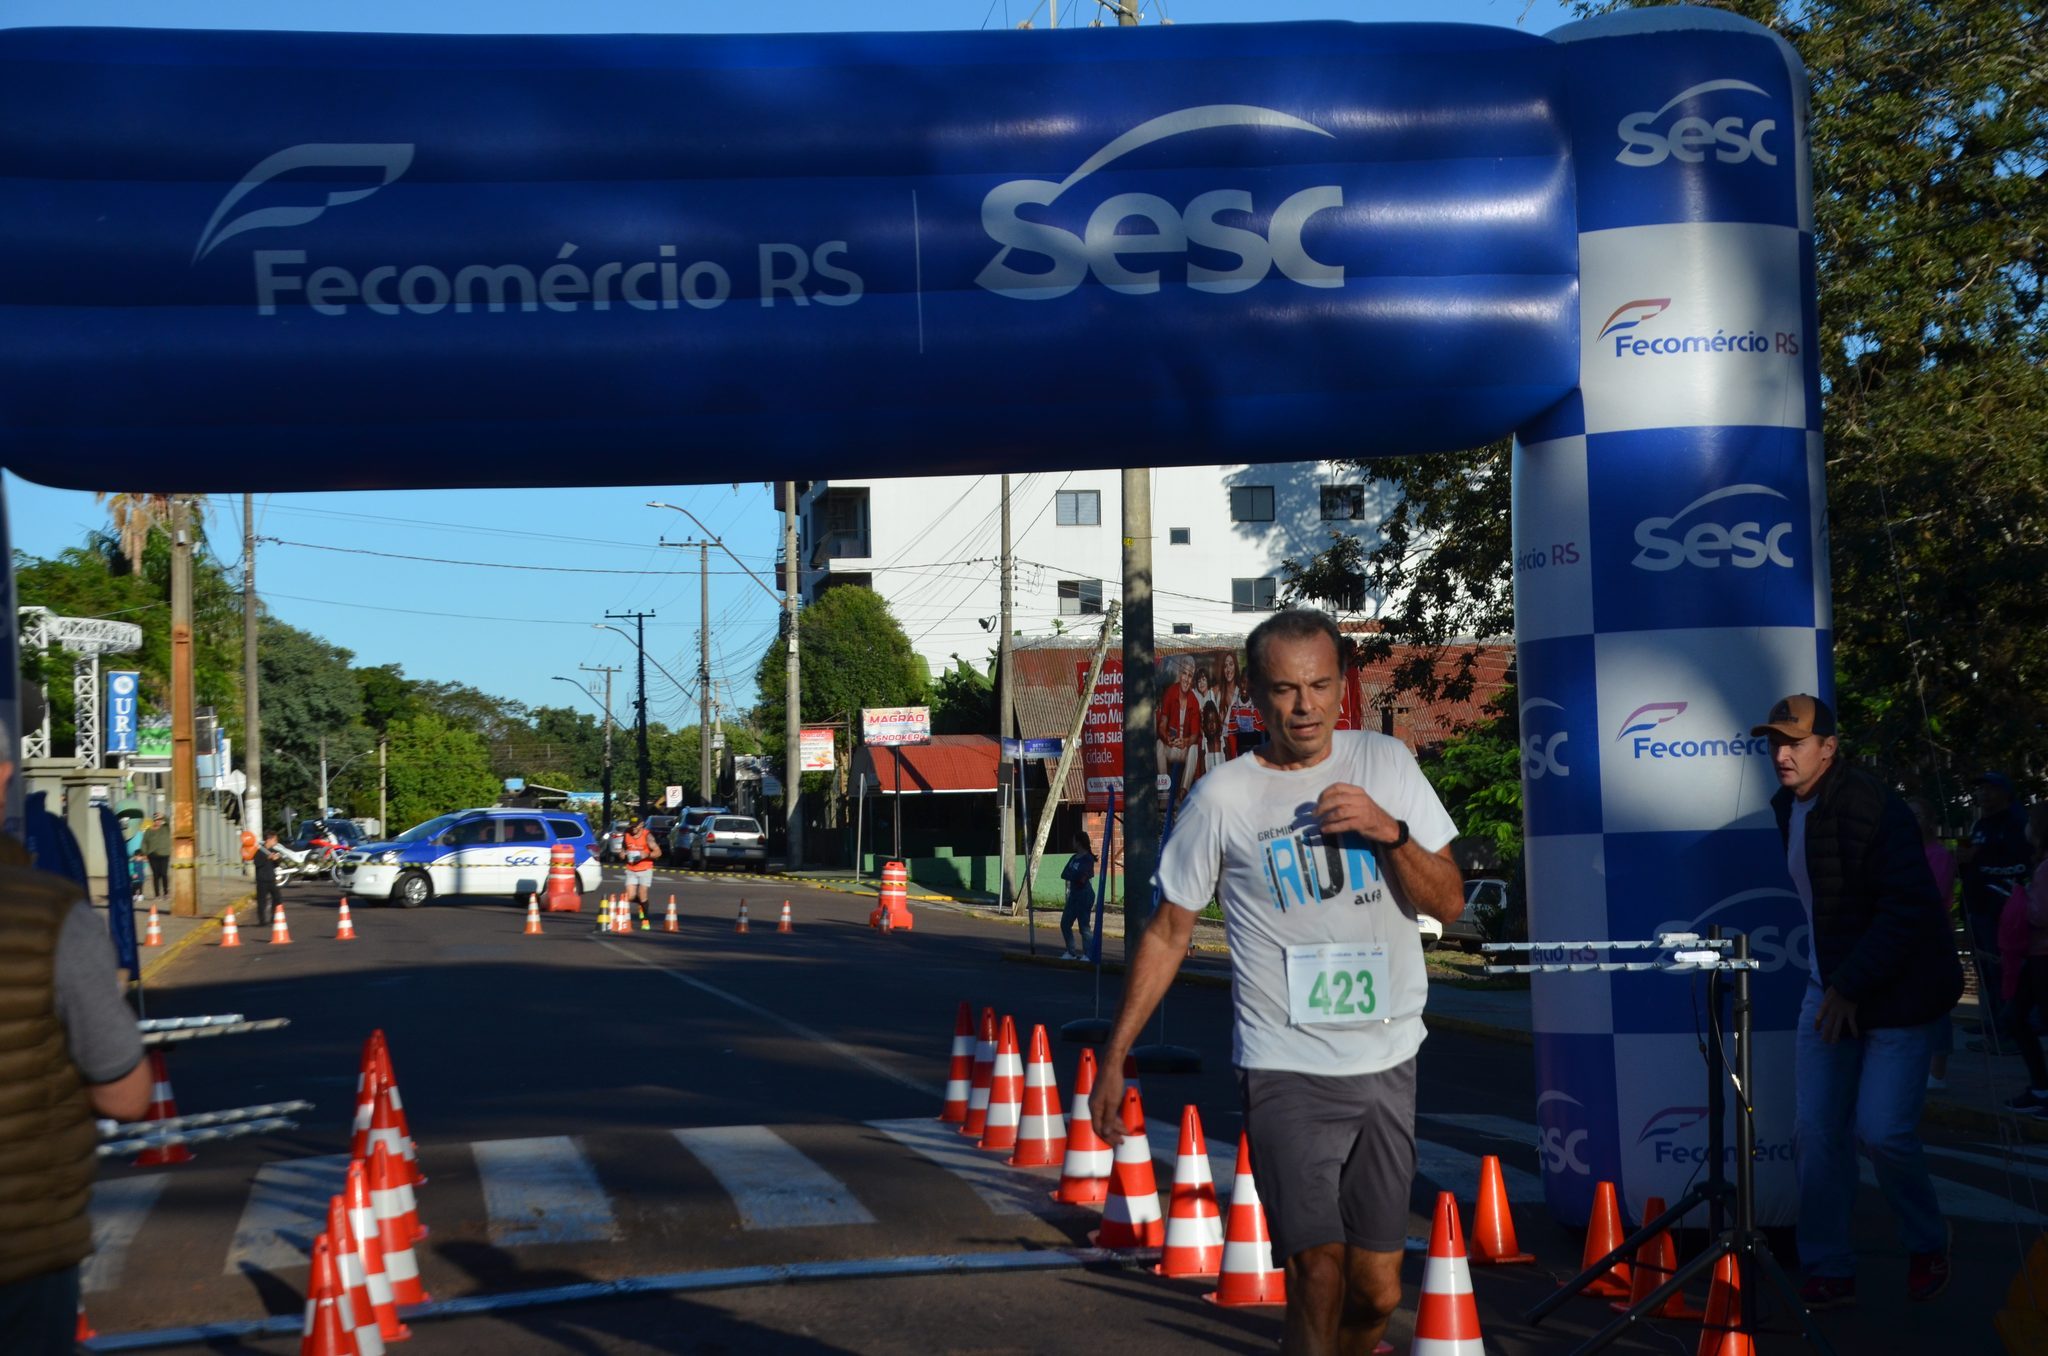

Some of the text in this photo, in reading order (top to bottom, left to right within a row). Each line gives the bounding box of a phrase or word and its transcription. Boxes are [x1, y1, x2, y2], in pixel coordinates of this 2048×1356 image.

[1615, 111, 1777, 167] Sesc
[974, 179, 1345, 300] Sesc
[253, 240, 864, 316] Fecomércio RS
[1616, 329, 1799, 357] Fecomércio RS
[1552, 542, 1580, 566] RS
[1631, 517, 1794, 571] Sesc
[114, 698, 132, 750] URI
[1094, 731, 1105, 744] na
[1106, 731, 1122, 743] sua
[1634, 732, 1769, 759] Fecomérc
[1308, 969, 1376, 1015] 423
